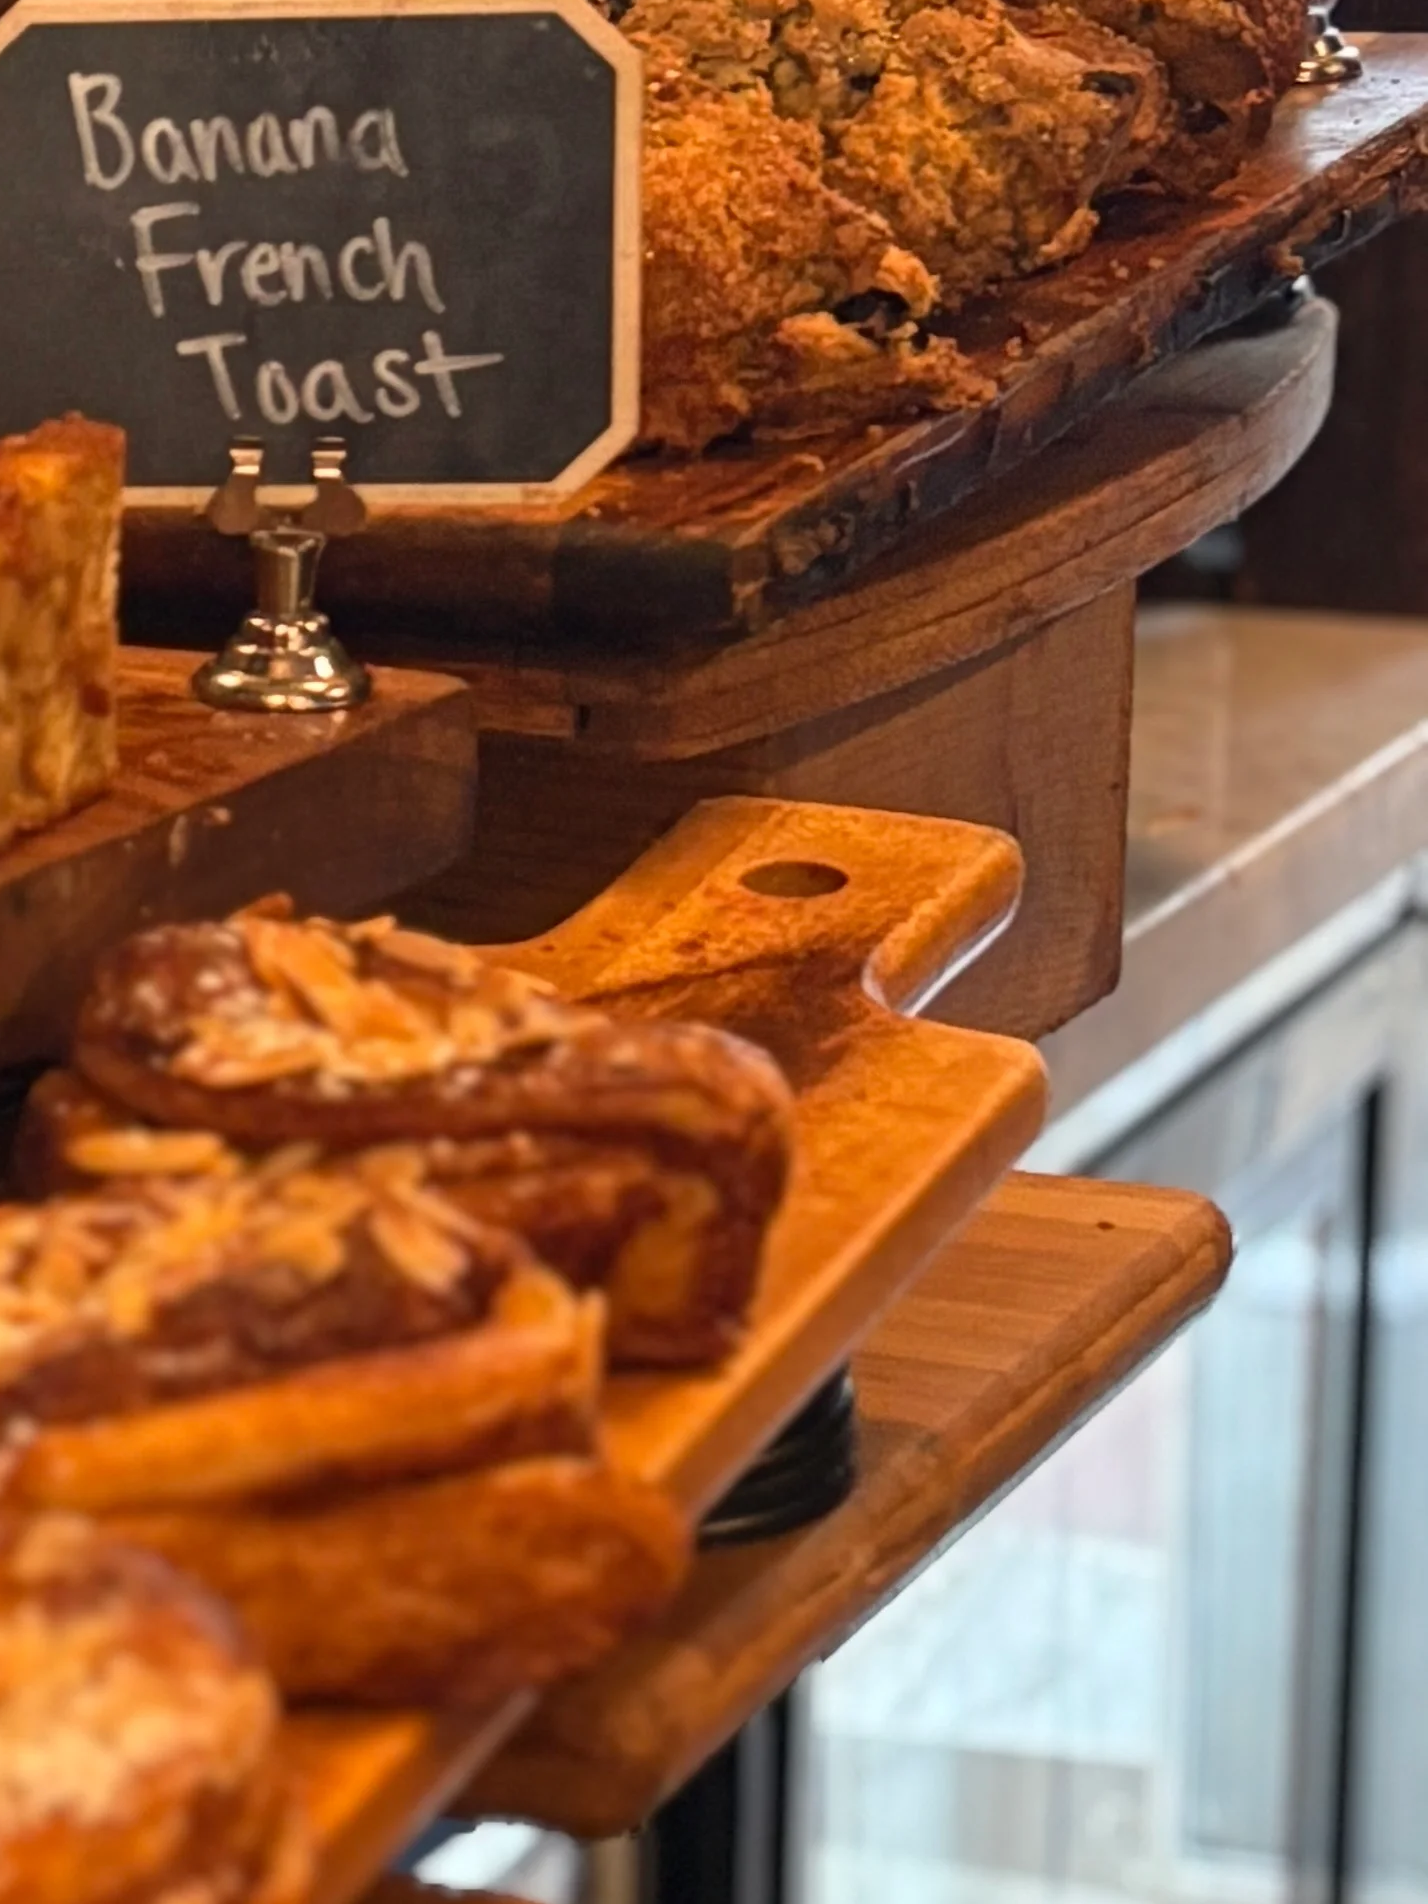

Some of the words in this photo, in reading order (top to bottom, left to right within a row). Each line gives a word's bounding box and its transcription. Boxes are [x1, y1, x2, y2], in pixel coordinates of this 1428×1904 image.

[67, 72, 410, 191] Banana
[129, 201, 446, 318] French
[175, 330, 505, 425] Toast
